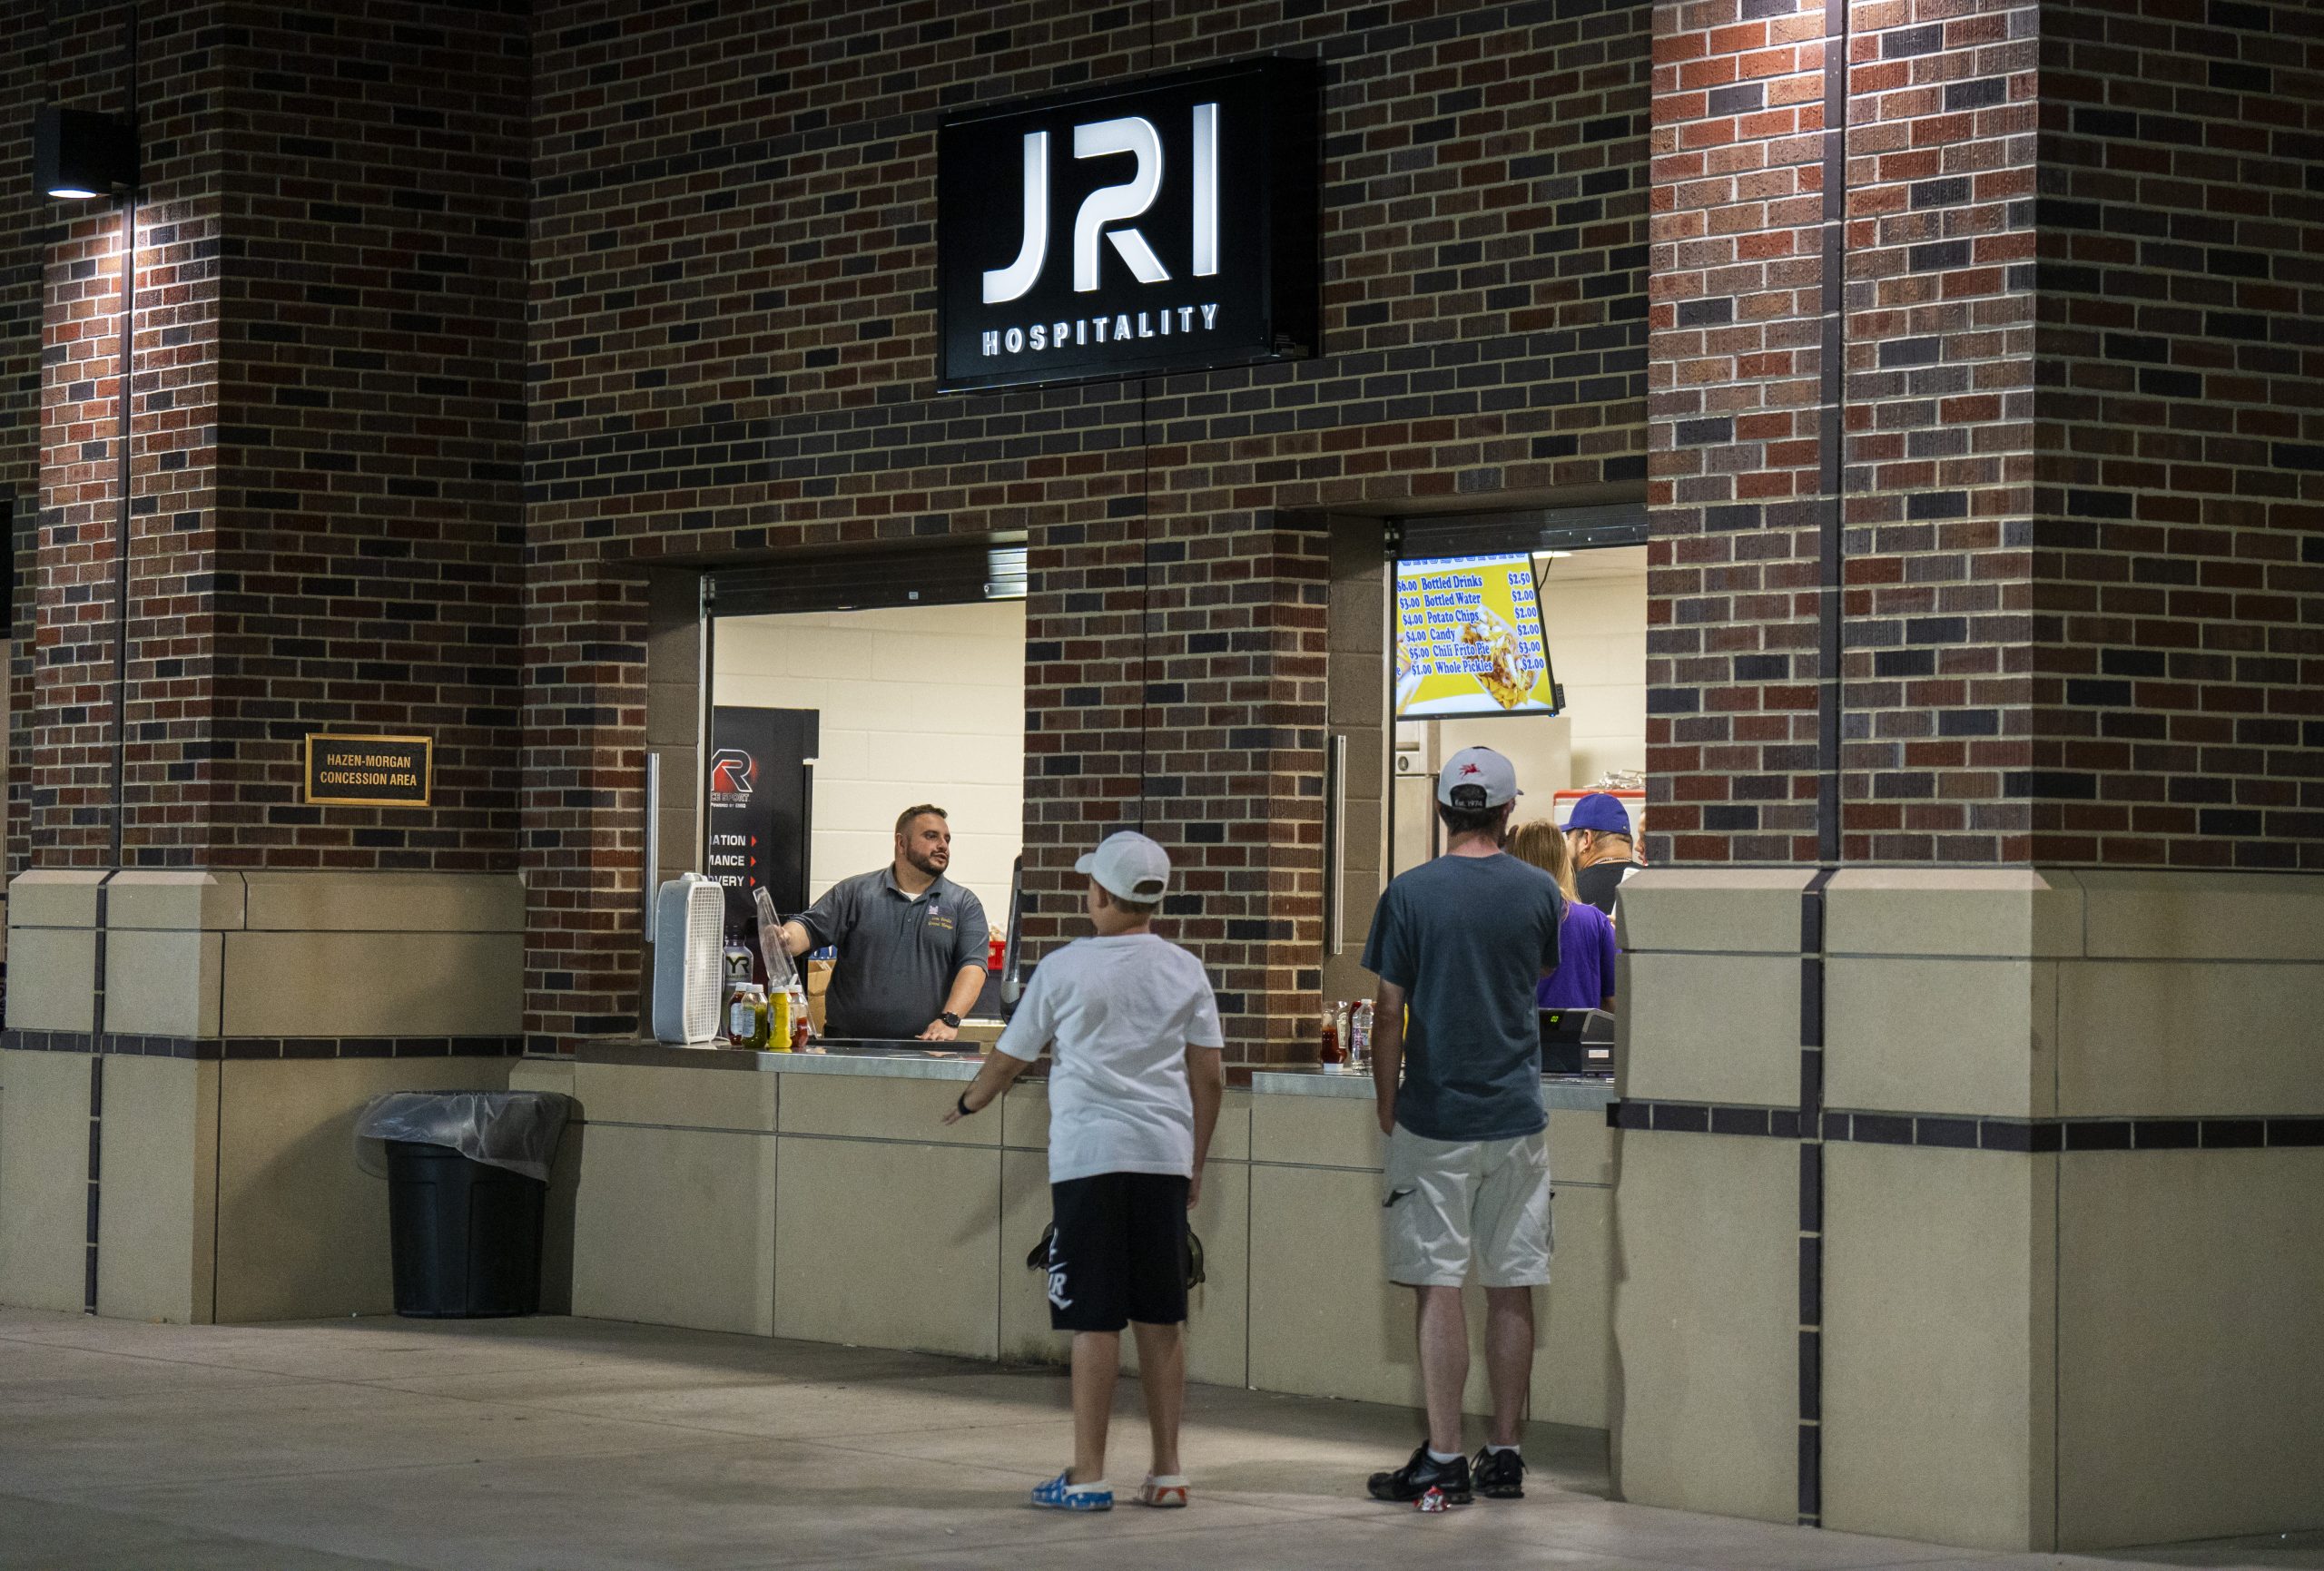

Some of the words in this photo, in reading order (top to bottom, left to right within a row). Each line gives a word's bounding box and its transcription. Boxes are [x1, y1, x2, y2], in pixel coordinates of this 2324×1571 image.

[982, 103, 1219, 304] JRI
[982, 303, 1219, 356] HOSPITALITY
[1397, 581, 1417, 592] $6.00
[1421, 575, 1451, 590] Bottled
[1453, 574, 1482, 588] Drinks
[1508, 573, 1531, 585] $2.50
[1399, 598, 1420, 609] $3.00
[1423, 594, 1454, 607] Bottled
[1455, 592, 1481, 604] Water
[1512, 590, 1534, 602] $2.00
[1403, 614, 1423, 626] $4.00
[1427, 611, 1452, 623] Potato
[1455, 609, 1480, 624] Chips
[1514, 607, 1537, 619] $2.00
[1406, 631, 1426, 643] $4.00
[1430, 628, 1455, 642] Candy
[1517, 623, 1539, 636] $2.00
[1409, 647, 1430, 660] $5.00
[1433, 644, 1452, 657] Chili
[1454, 643, 1475, 655] Frito
[1477, 642, 1490, 654] Pie
[1518, 642, 1541, 653] $3.00
[1412, 664, 1432, 676] $1.00
[1435, 661, 1461, 673] Whole
[1462, 660, 1493, 673] Pickles
[1521, 658, 1544, 671] $2.00
[327, 753, 411, 768] HAZEN-MORGAN
[320, 771, 388, 785] CONCESSION
[389, 773, 418, 786] AREA
[710, 834, 746, 846] ATION
